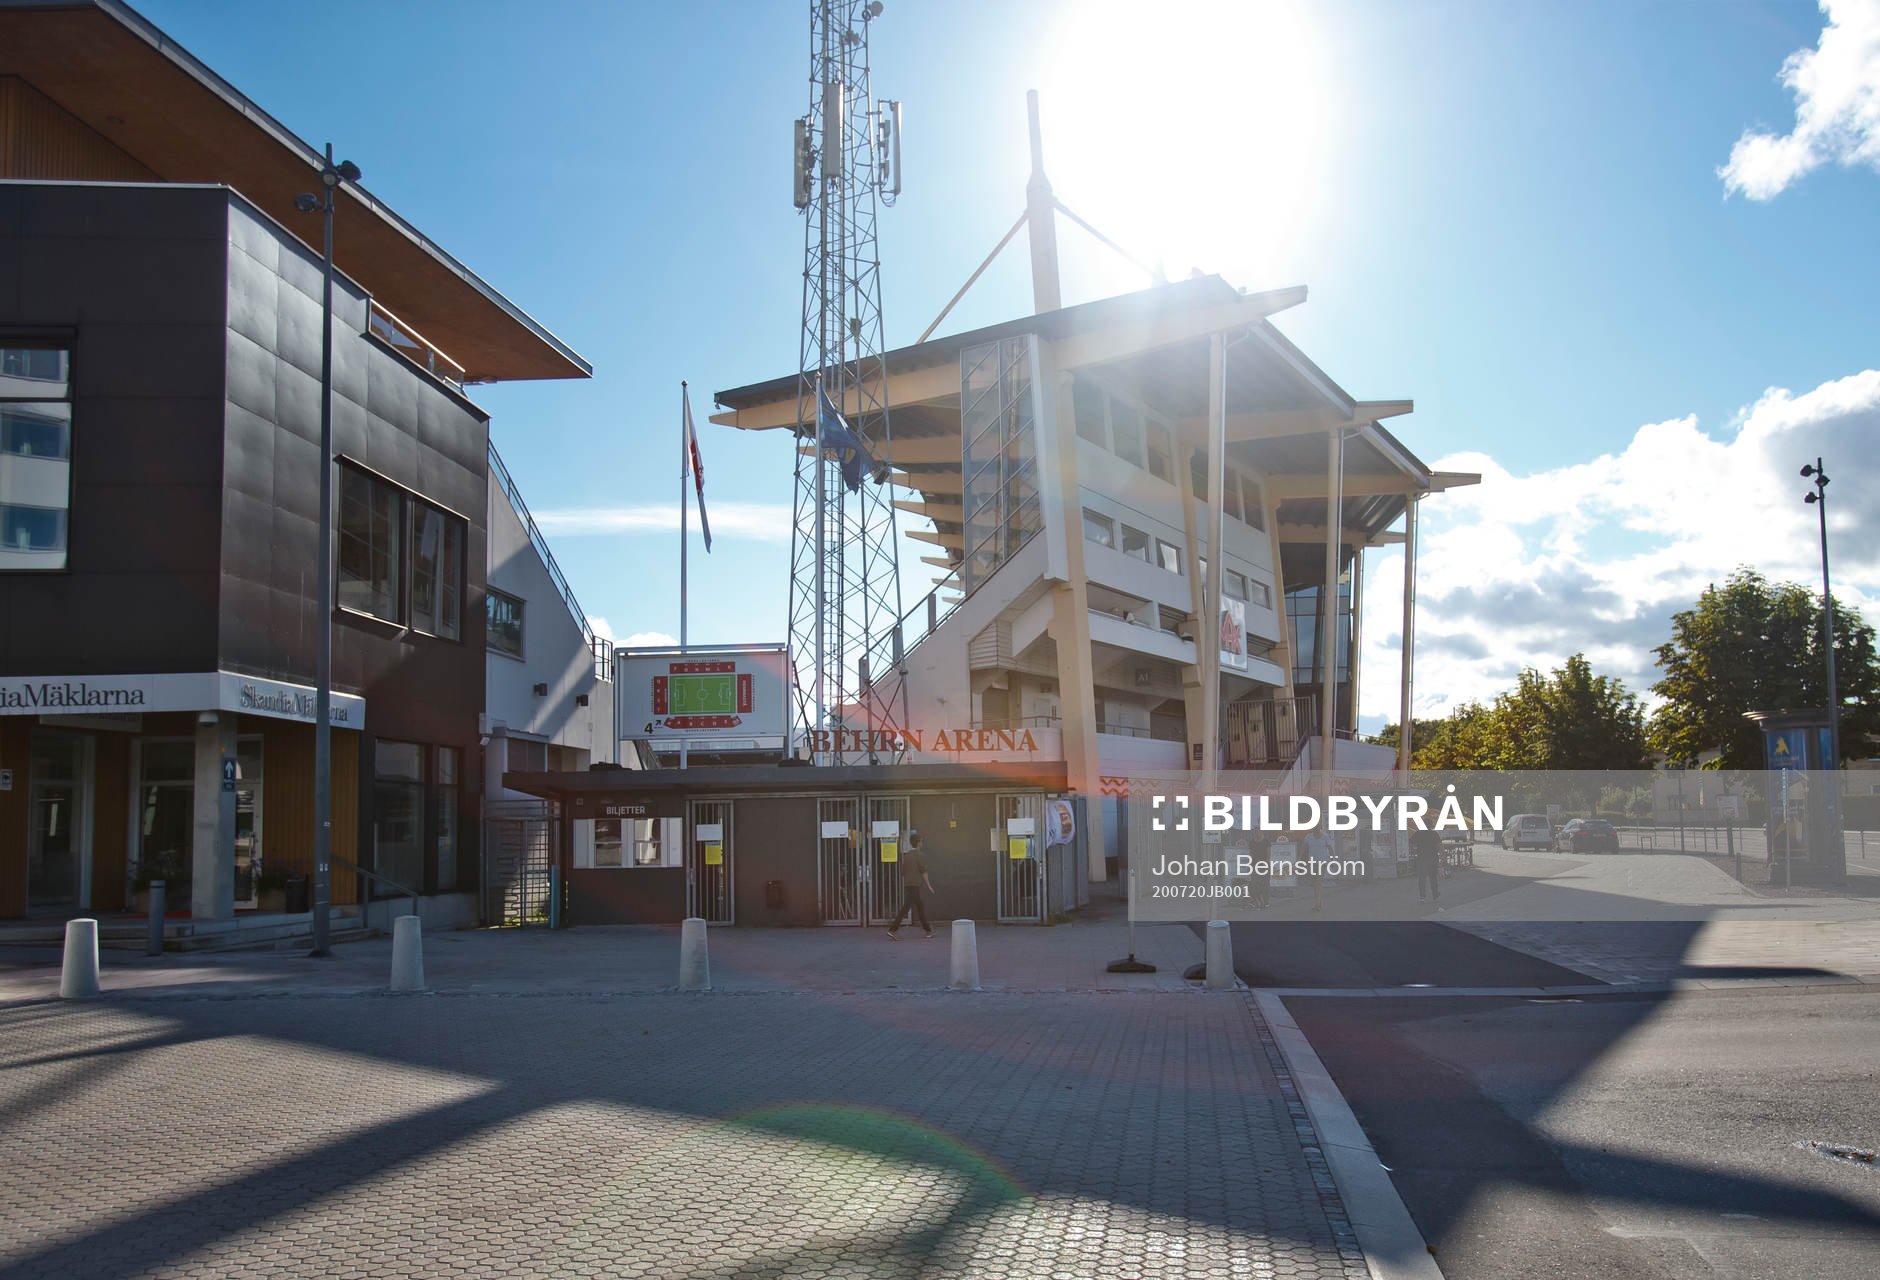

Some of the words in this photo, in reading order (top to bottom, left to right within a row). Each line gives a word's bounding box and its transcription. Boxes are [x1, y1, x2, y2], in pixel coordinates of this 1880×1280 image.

[812, 728, 924, 753] BEHRN
[930, 728, 1039, 751] ARENA
[606, 805, 646, 817] BILJETTER
